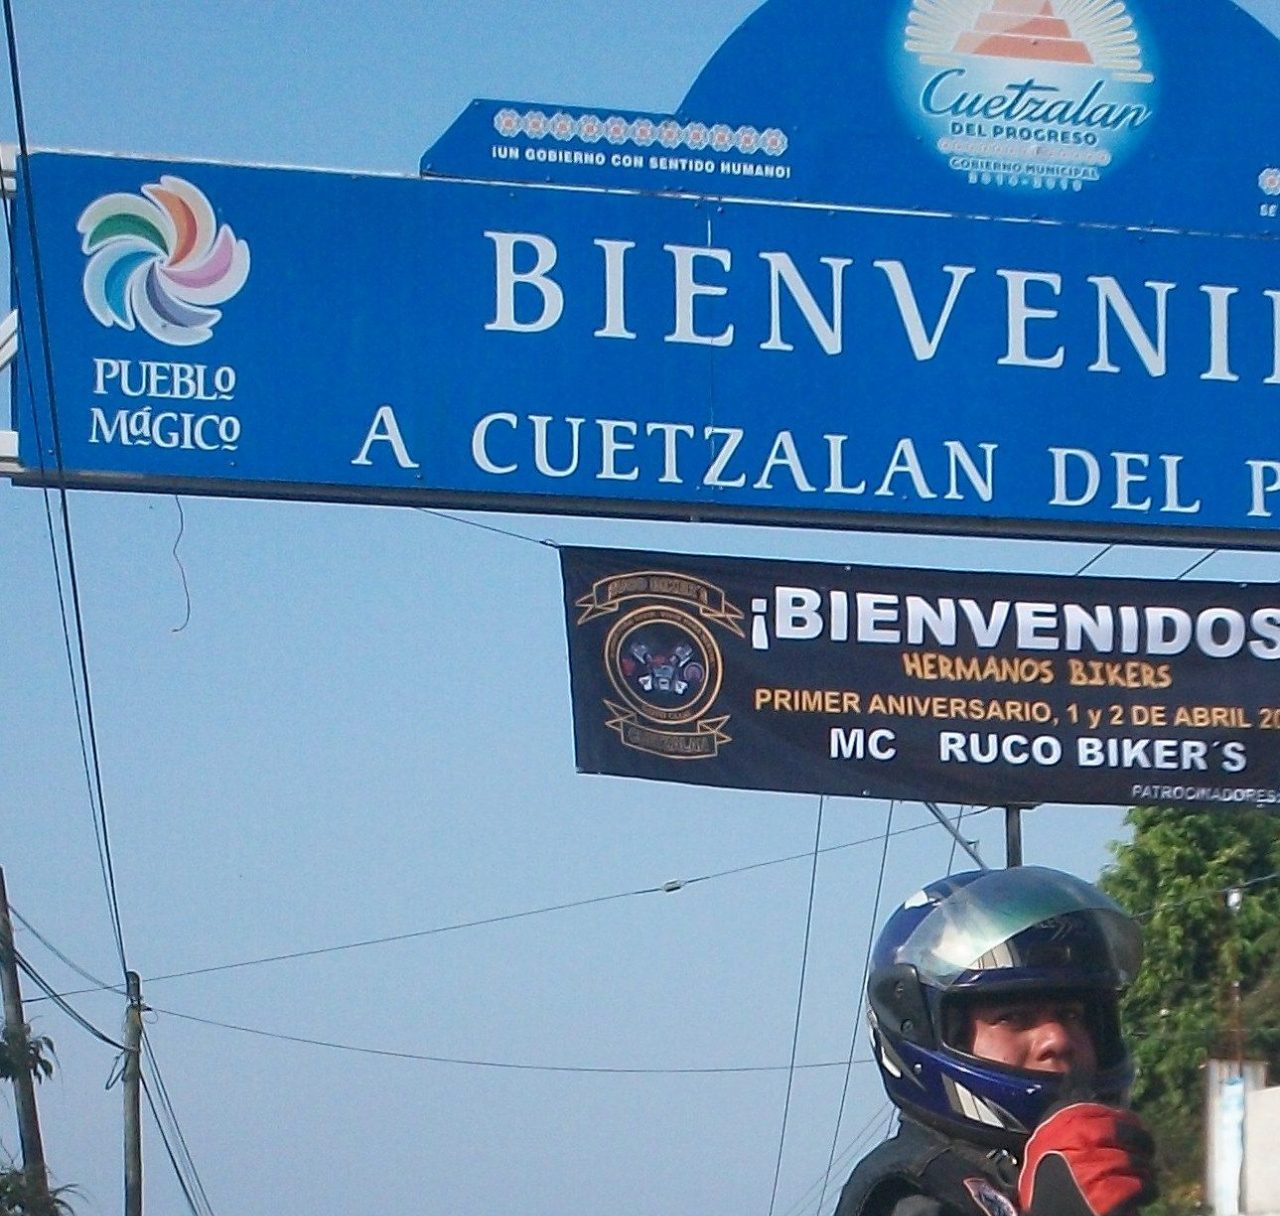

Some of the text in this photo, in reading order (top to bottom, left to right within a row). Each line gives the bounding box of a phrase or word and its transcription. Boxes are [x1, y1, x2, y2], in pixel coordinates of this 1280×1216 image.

[919, 68, 1153, 130] Cuetzalan
[951, 122, 1098, 146] DEL PROGRESO
[525, 148, 605, 166] GOBIERNO
[611, 153, 643, 168] CON
[650, 156, 715, 173] SENTIDO
[950, 157, 1100, 180] GOBIERNO MUNICIPAL
[1260, 205, 1277, 217] SE
[351, 405, 420, 468] A
[470, 411, 999, 502] CUETZALAN
[1048, 446, 1201, 515] DEL
[902, 651, 1174, 690] HERMANOS BIKERS
[754, 687, 862, 714] PRIMER
[868, 694, 1061, 727] ANIVERSARIO,
[1066, 703, 1080, 724] 1
[1087, 707, 1102, 730] y
[1108, 704, 1126, 726] 2
[1131, 705, 1168, 727] DE
[1172, 706, 1253, 729] ABRIL
[829, 727, 897, 761] MC
[938, 730, 1063, 767] RUCO
